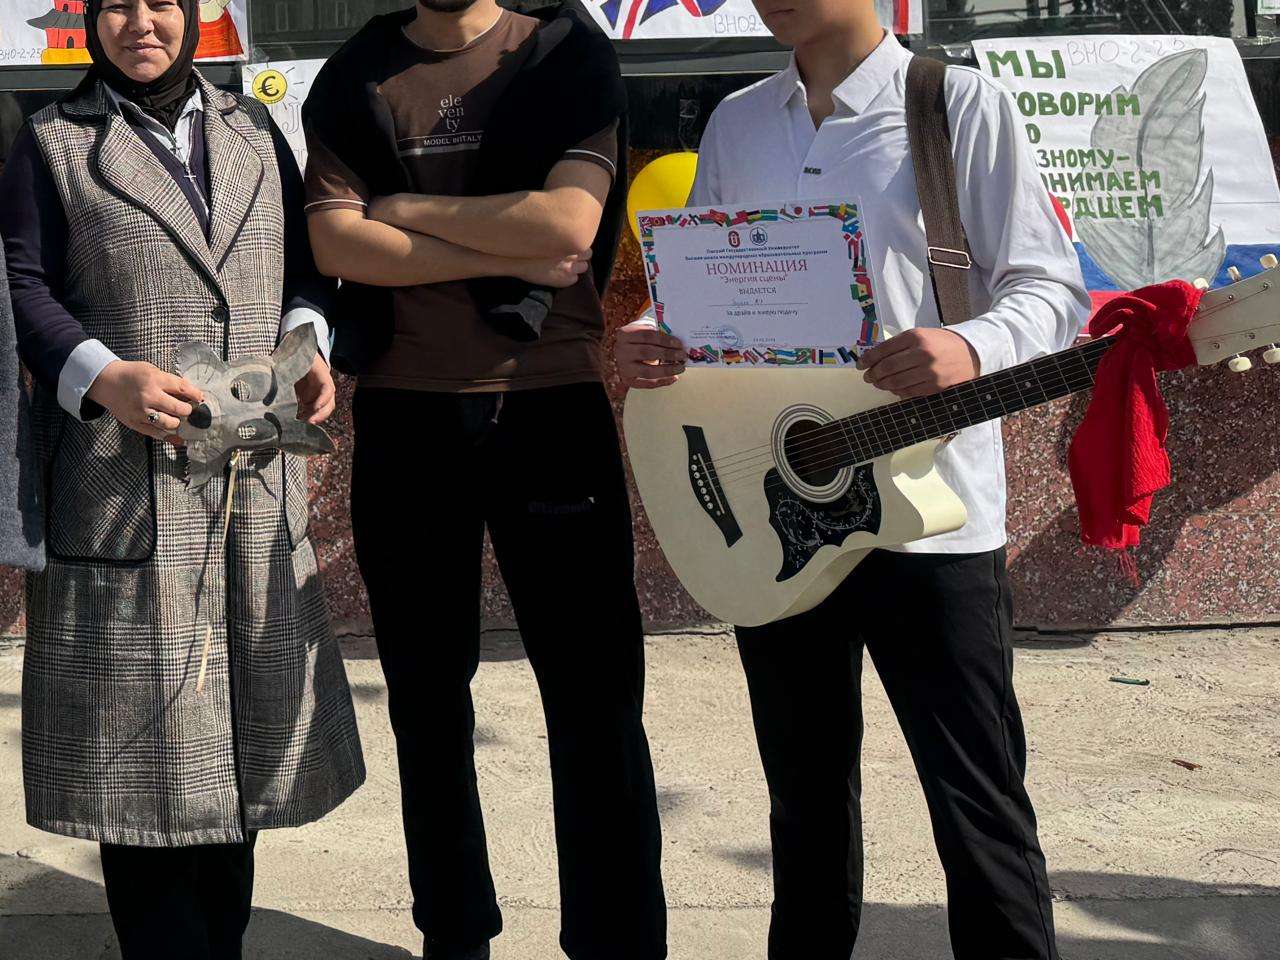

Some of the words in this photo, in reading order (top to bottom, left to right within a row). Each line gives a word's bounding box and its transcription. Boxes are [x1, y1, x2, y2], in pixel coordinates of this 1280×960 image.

[984, 48, 1067, 79] МЫ
[1011, 91, 1141, 117] ОВОРИМ
[1035, 148, 1130, 170] ЗНОМУ-
[1040, 170, 1162, 192] НИМАЕМ
[1056, 195, 1164, 219] РДЦЕМ
[706, 259, 808, 275] НОМИНАЦИЯ
